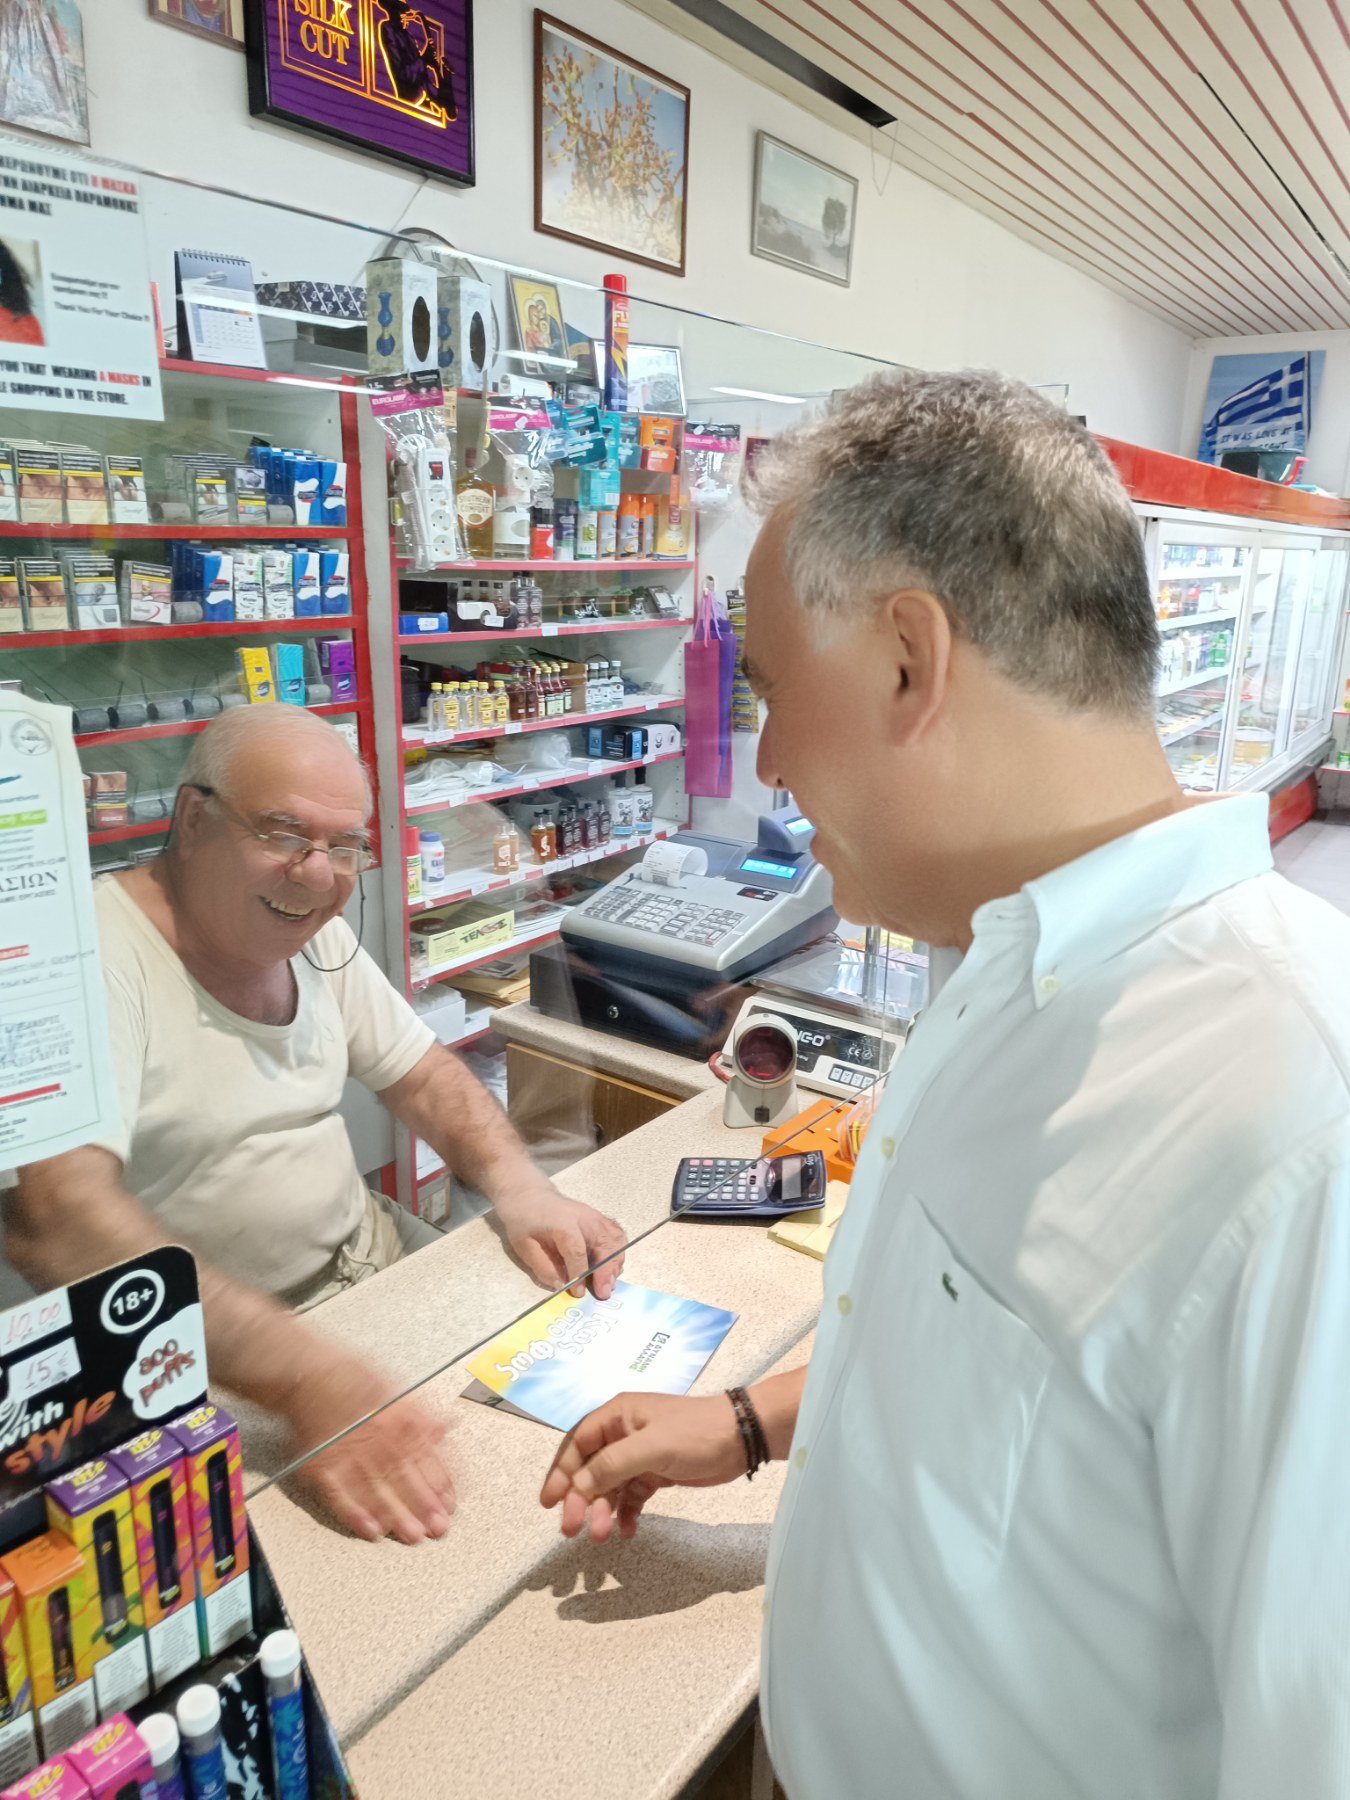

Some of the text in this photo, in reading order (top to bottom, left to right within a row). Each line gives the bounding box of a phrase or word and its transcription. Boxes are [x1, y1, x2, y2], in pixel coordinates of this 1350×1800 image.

[300, 20, 350, 66] CUT
[10, 382, 62, 399] SHOPPING
[64, 388, 74, 400] IN
[77, 389, 95, 402] THE
[97, 391, 128, 405] STORE.
[21, 361, 46, 376] THAT
[51, 365, 97, 382] WEARING
[99, 371, 107, 382] A
[108, 371, 141, 387] MASKS
[142, 376, 152, 387] IN
[112, 1287, 154, 1316] 18+
[139, 1338, 179, 1376] 800
[494, 1338, 556, 1382] Φως
[139, 1350, 196, 1408] puffs
[4, 1391, 117, 1475] style
